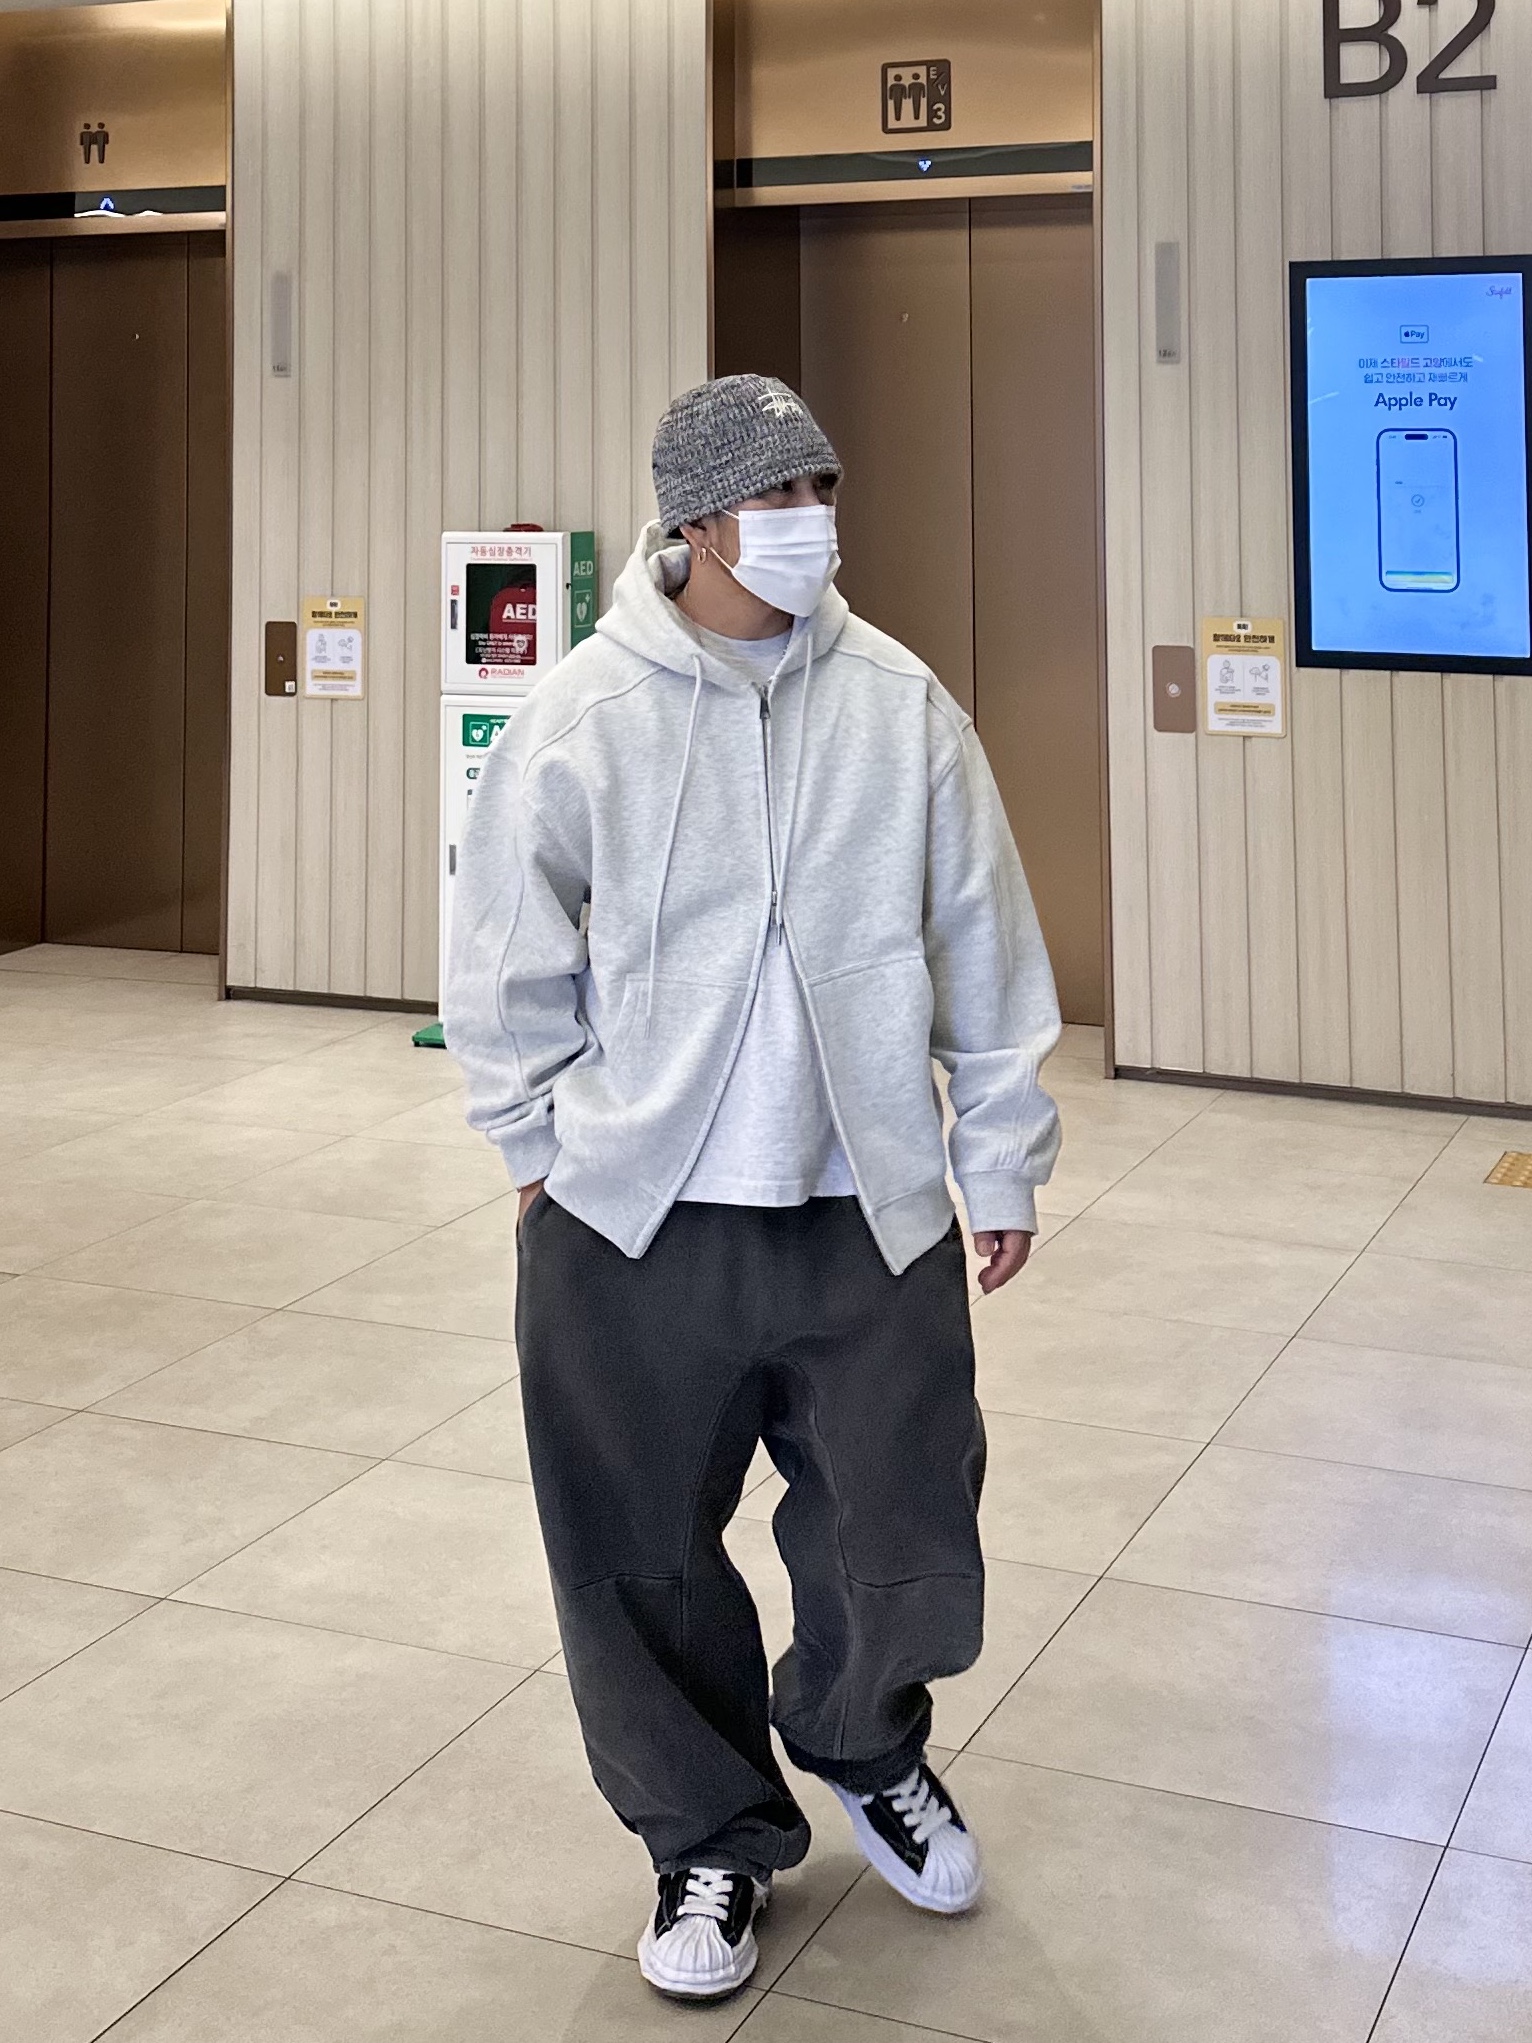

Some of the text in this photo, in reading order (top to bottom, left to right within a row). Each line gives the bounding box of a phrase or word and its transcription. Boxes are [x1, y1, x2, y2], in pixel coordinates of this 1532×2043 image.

[1323, 0, 1497, 99] B2
[932, 103, 946, 124] 3
[1358, 358, 1378, 369] 이제
[1374, 391, 1457, 411] Apple Pay
[471, 546, 532, 557] 자동심장충격기
[573, 560, 594, 576] AED
[502, 603, 537, 619] AED
[490, 668, 525, 676] RADIAN
